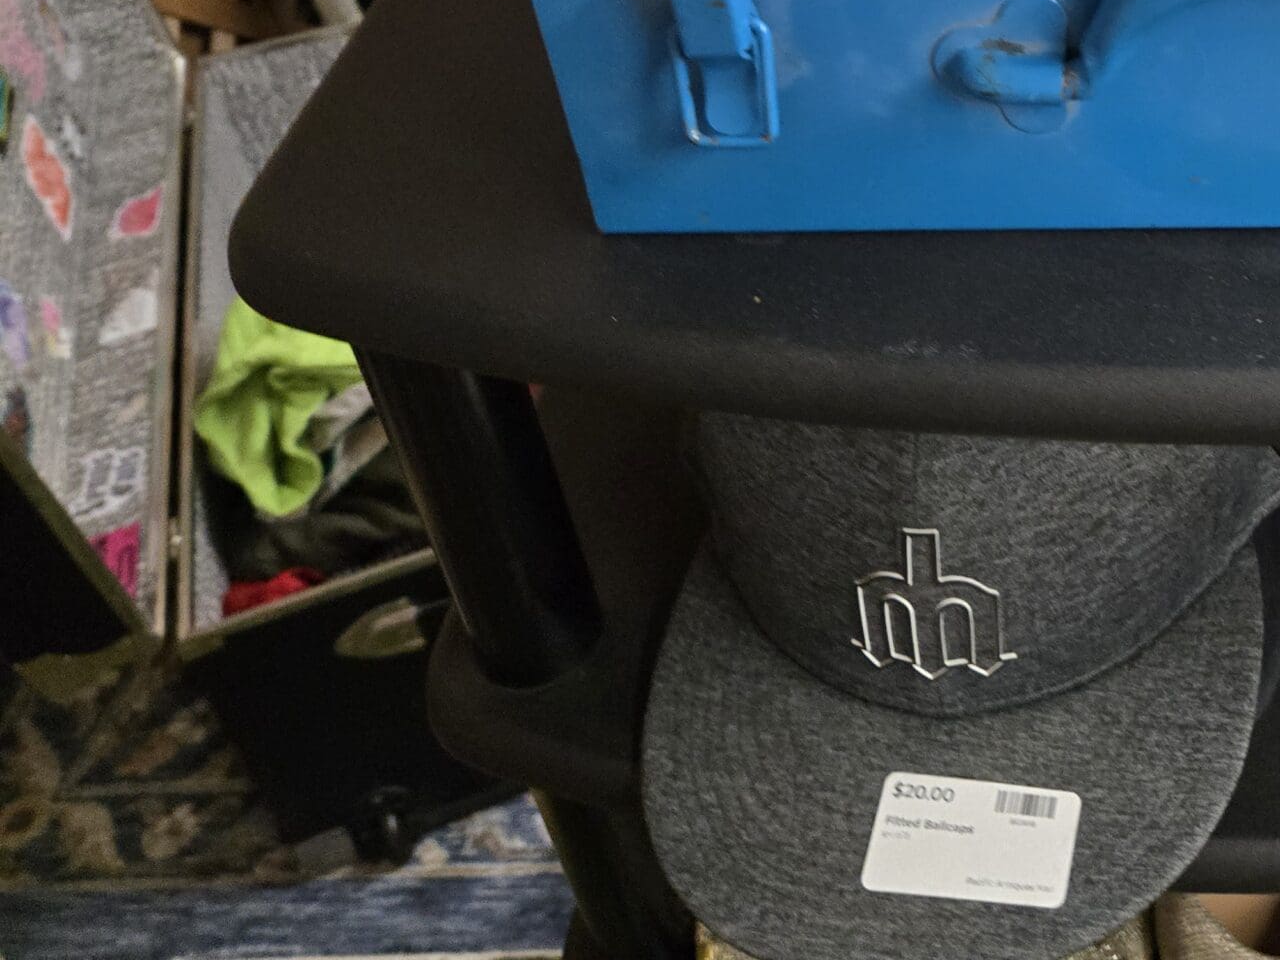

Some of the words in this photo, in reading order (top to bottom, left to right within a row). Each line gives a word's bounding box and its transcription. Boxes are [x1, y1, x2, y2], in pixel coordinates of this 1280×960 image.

[892, 782, 955, 803] $20.00
[885, 814, 921, 830] Fitted
[923, 818, 975, 835] Ballcaps
